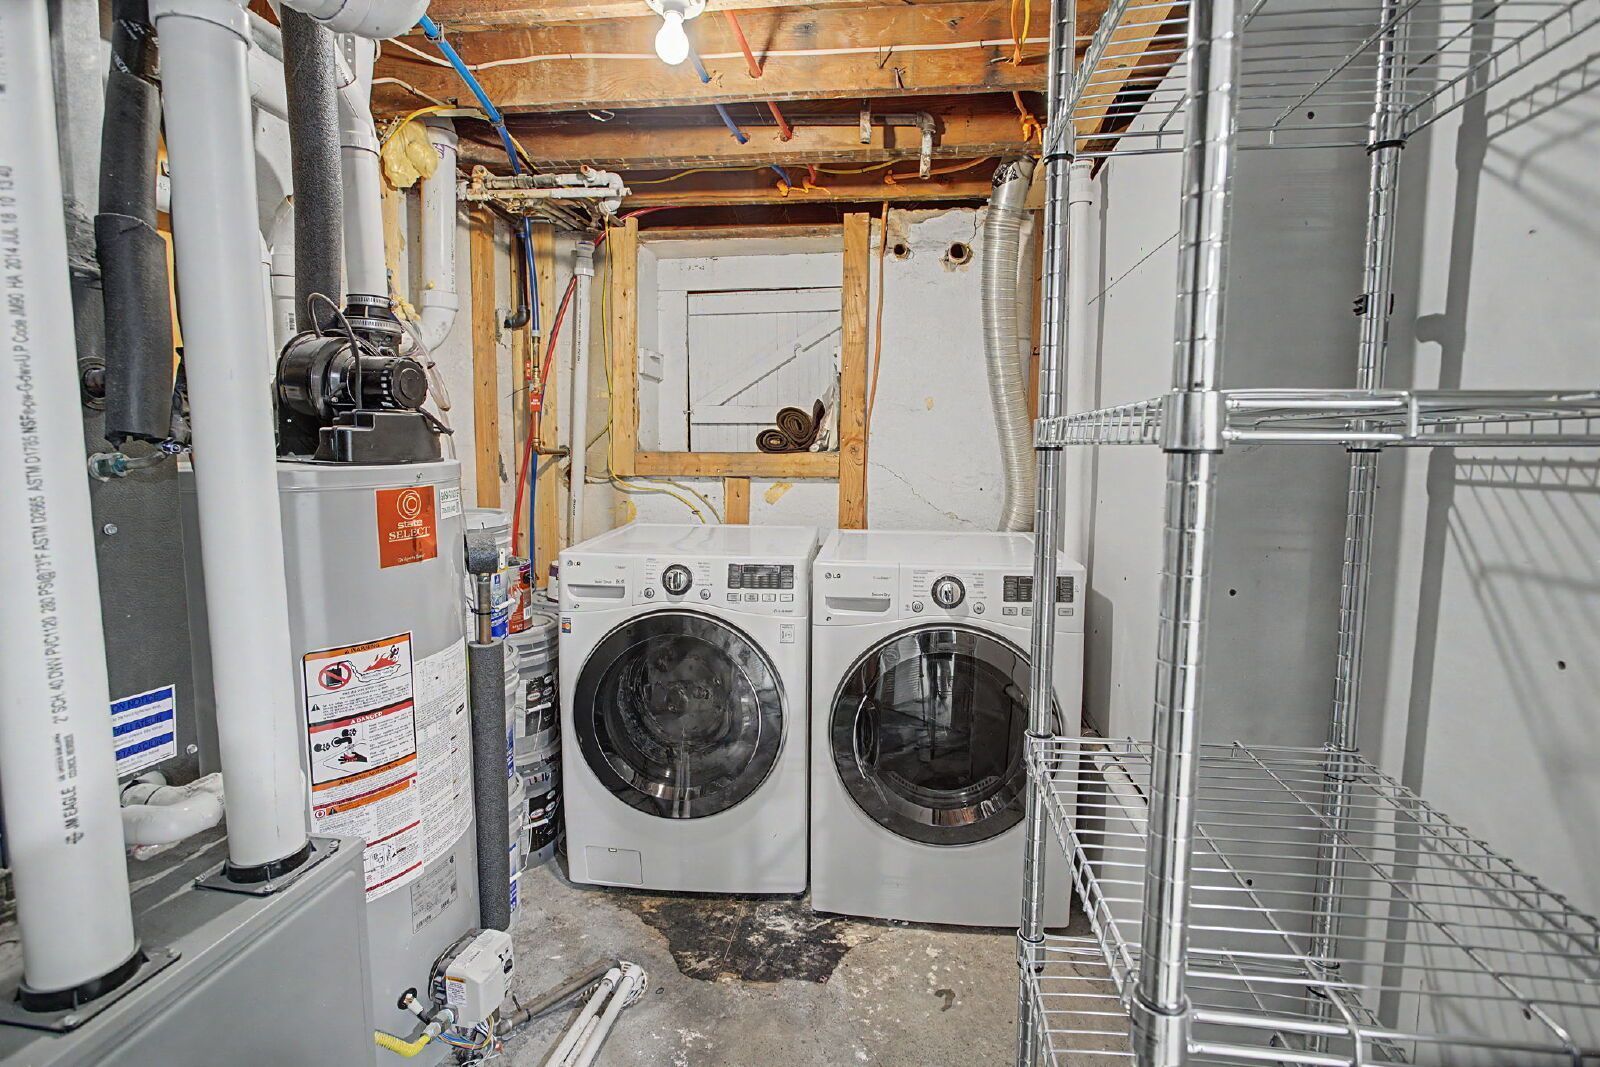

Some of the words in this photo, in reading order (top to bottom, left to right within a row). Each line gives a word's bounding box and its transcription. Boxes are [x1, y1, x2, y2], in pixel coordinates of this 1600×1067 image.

[1, 228, 21, 245] JUL
[2, 248, 22, 270] 2014
[5, 274, 23, 289] HA
[8, 294, 27, 317] JM90
[21, 435, 41, 463] D1785
[25, 465, 43, 491] ASTM
[28, 496, 47, 523] D2665
[388, 526, 429, 540] SELECT
[397, 519, 423, 530] state
[31, 526, 49, 551] ASTM
[39, 597, 57, 614] 280
[41, 615, 60, 656] PVC1120
[45, 658, 64, 677] DWV
[49, 678, 65, 690] 40
[356, 711, 383, 723] DANGER
[61, 785, 79, 817] EAGLE
[65, 817, 80, 830] JM
